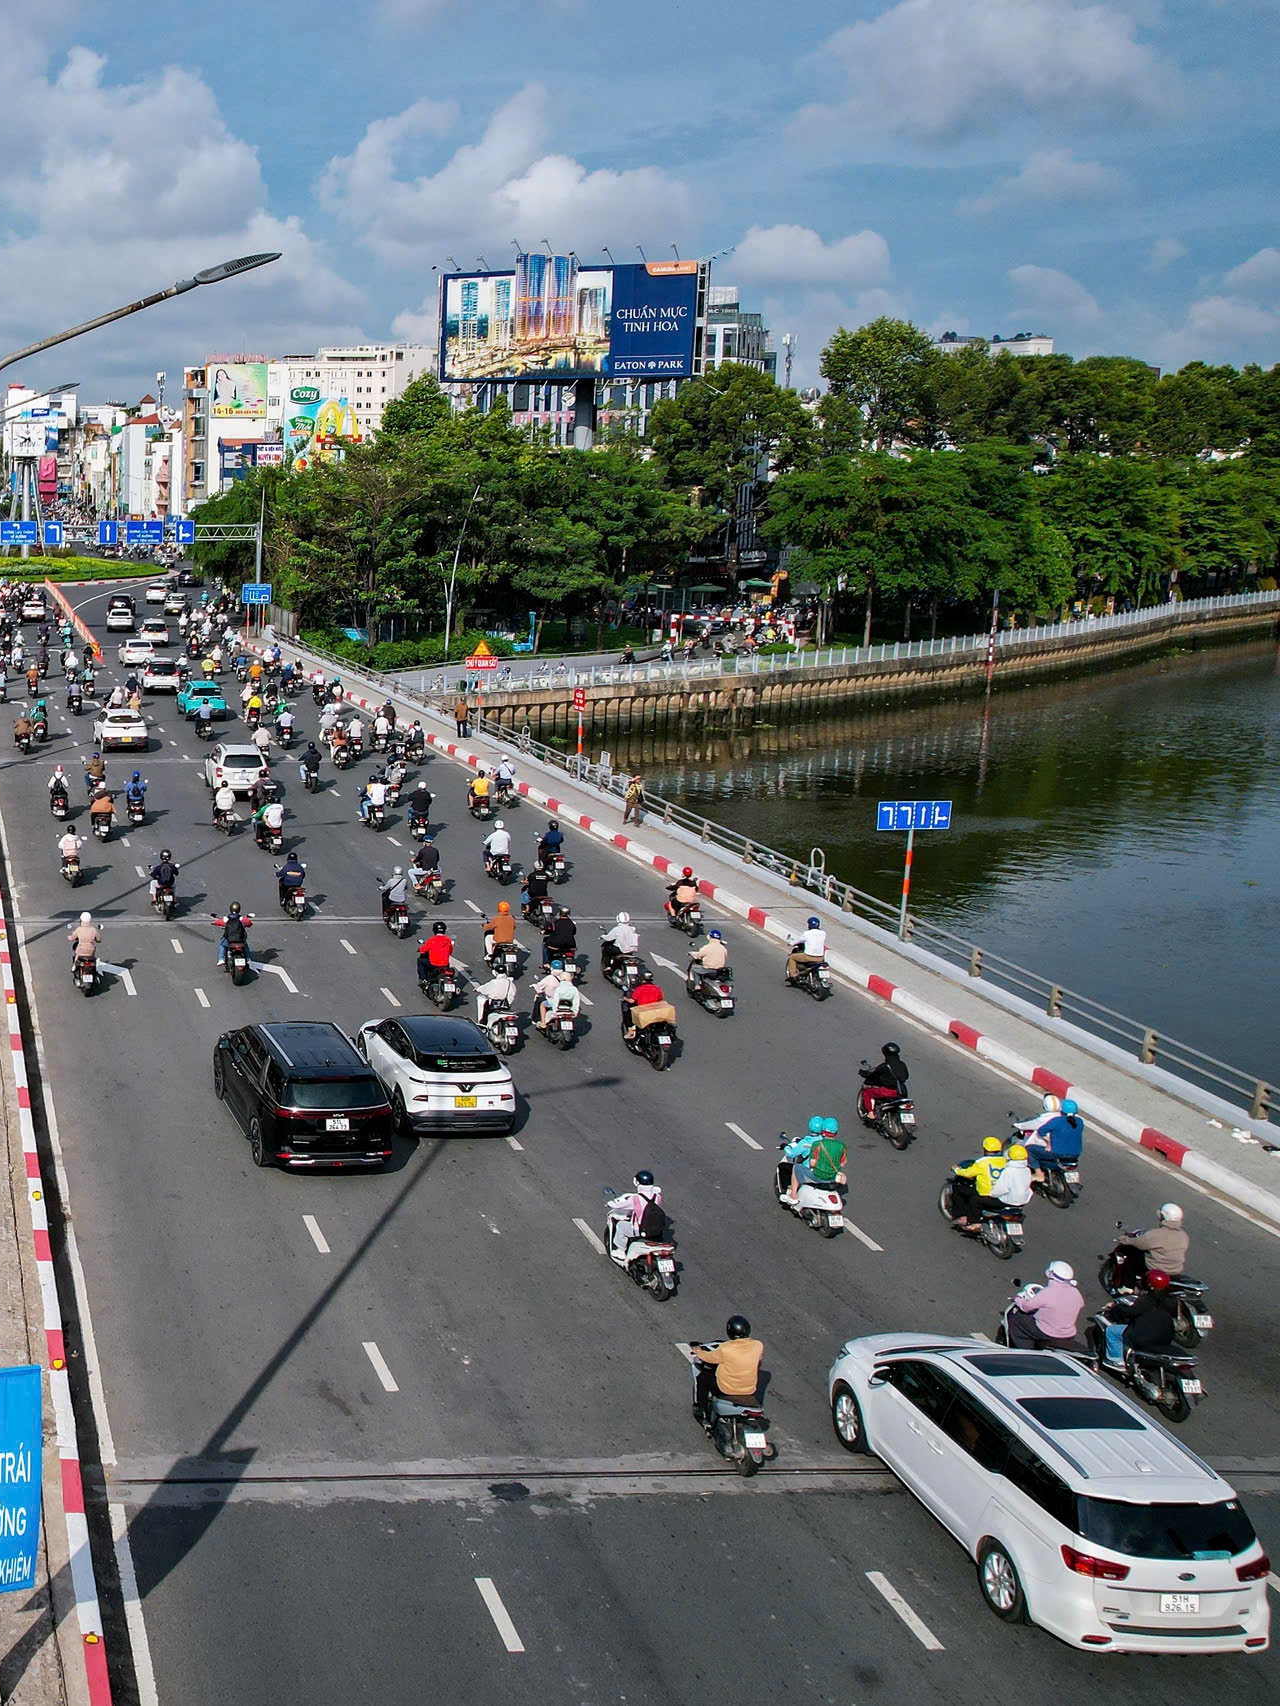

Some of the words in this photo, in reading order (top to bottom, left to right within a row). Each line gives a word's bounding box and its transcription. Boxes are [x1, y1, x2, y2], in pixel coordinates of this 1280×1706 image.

[616, 305, 657, 319] CHUẨN
[660, 306, 688, 319] MỰC
[623, 321, 650, 333] TINH
[653, 321, 679, 332] HOA
[614, 361, 646, 370] EATON
[658, 360, 684, 369] PARK
[292, 389, 318, 400] Cozy
[1172, 1595, 1189, 1603] 51H
